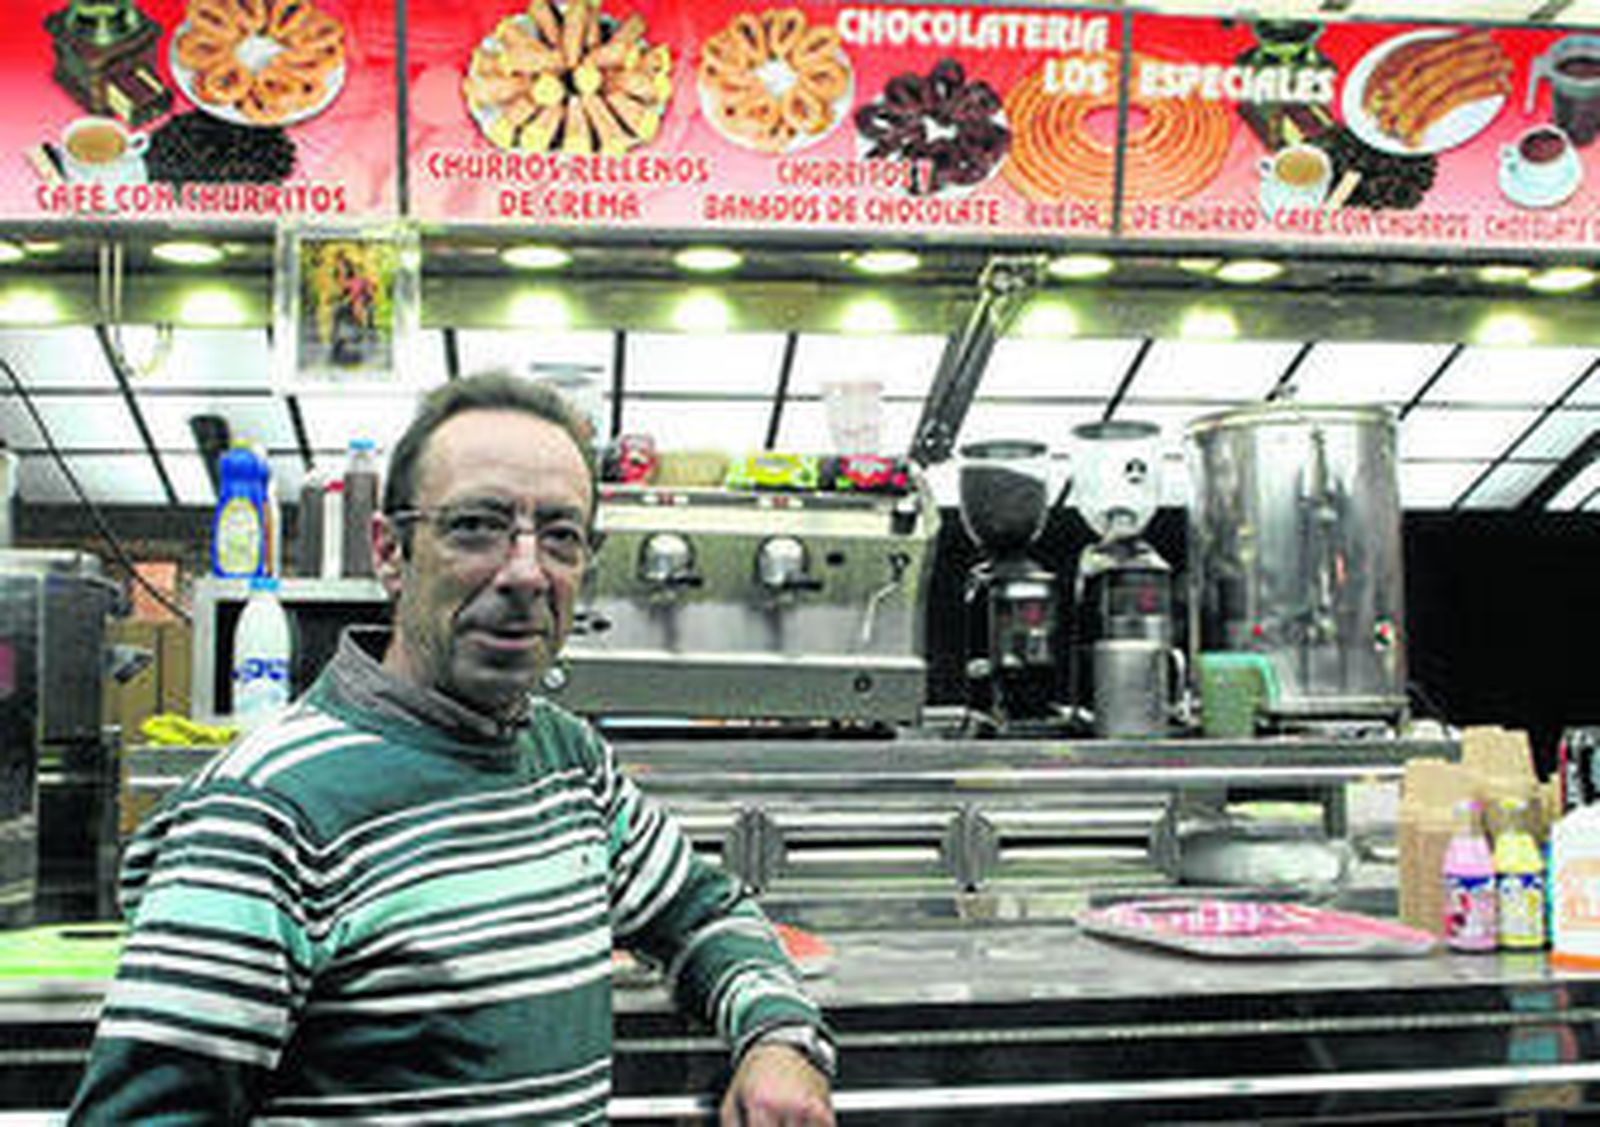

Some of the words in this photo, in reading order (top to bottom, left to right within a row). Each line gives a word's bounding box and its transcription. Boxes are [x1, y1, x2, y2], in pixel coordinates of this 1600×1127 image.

[837, 9, 1109, 51] CHOCOLATERIA
[1043, 58, 1108, 94] LOS
[1138, 60, 1336, 104] ESPECIALES
[427, 152, 561, 181] CHURROS
[567, 154, 709, 183] RELLENOS
[114, 185, 176, 212] CON
[181, 184, 347, 214] CHURRITOS
[499, 190, 534, 217] DE
[543, 190, 641, 219] CREMA
[826, 196, 858, 223] DE
[864, 197, 1001, 225] CHOCOLATE
[1133, 204, 1162, 231] DE
